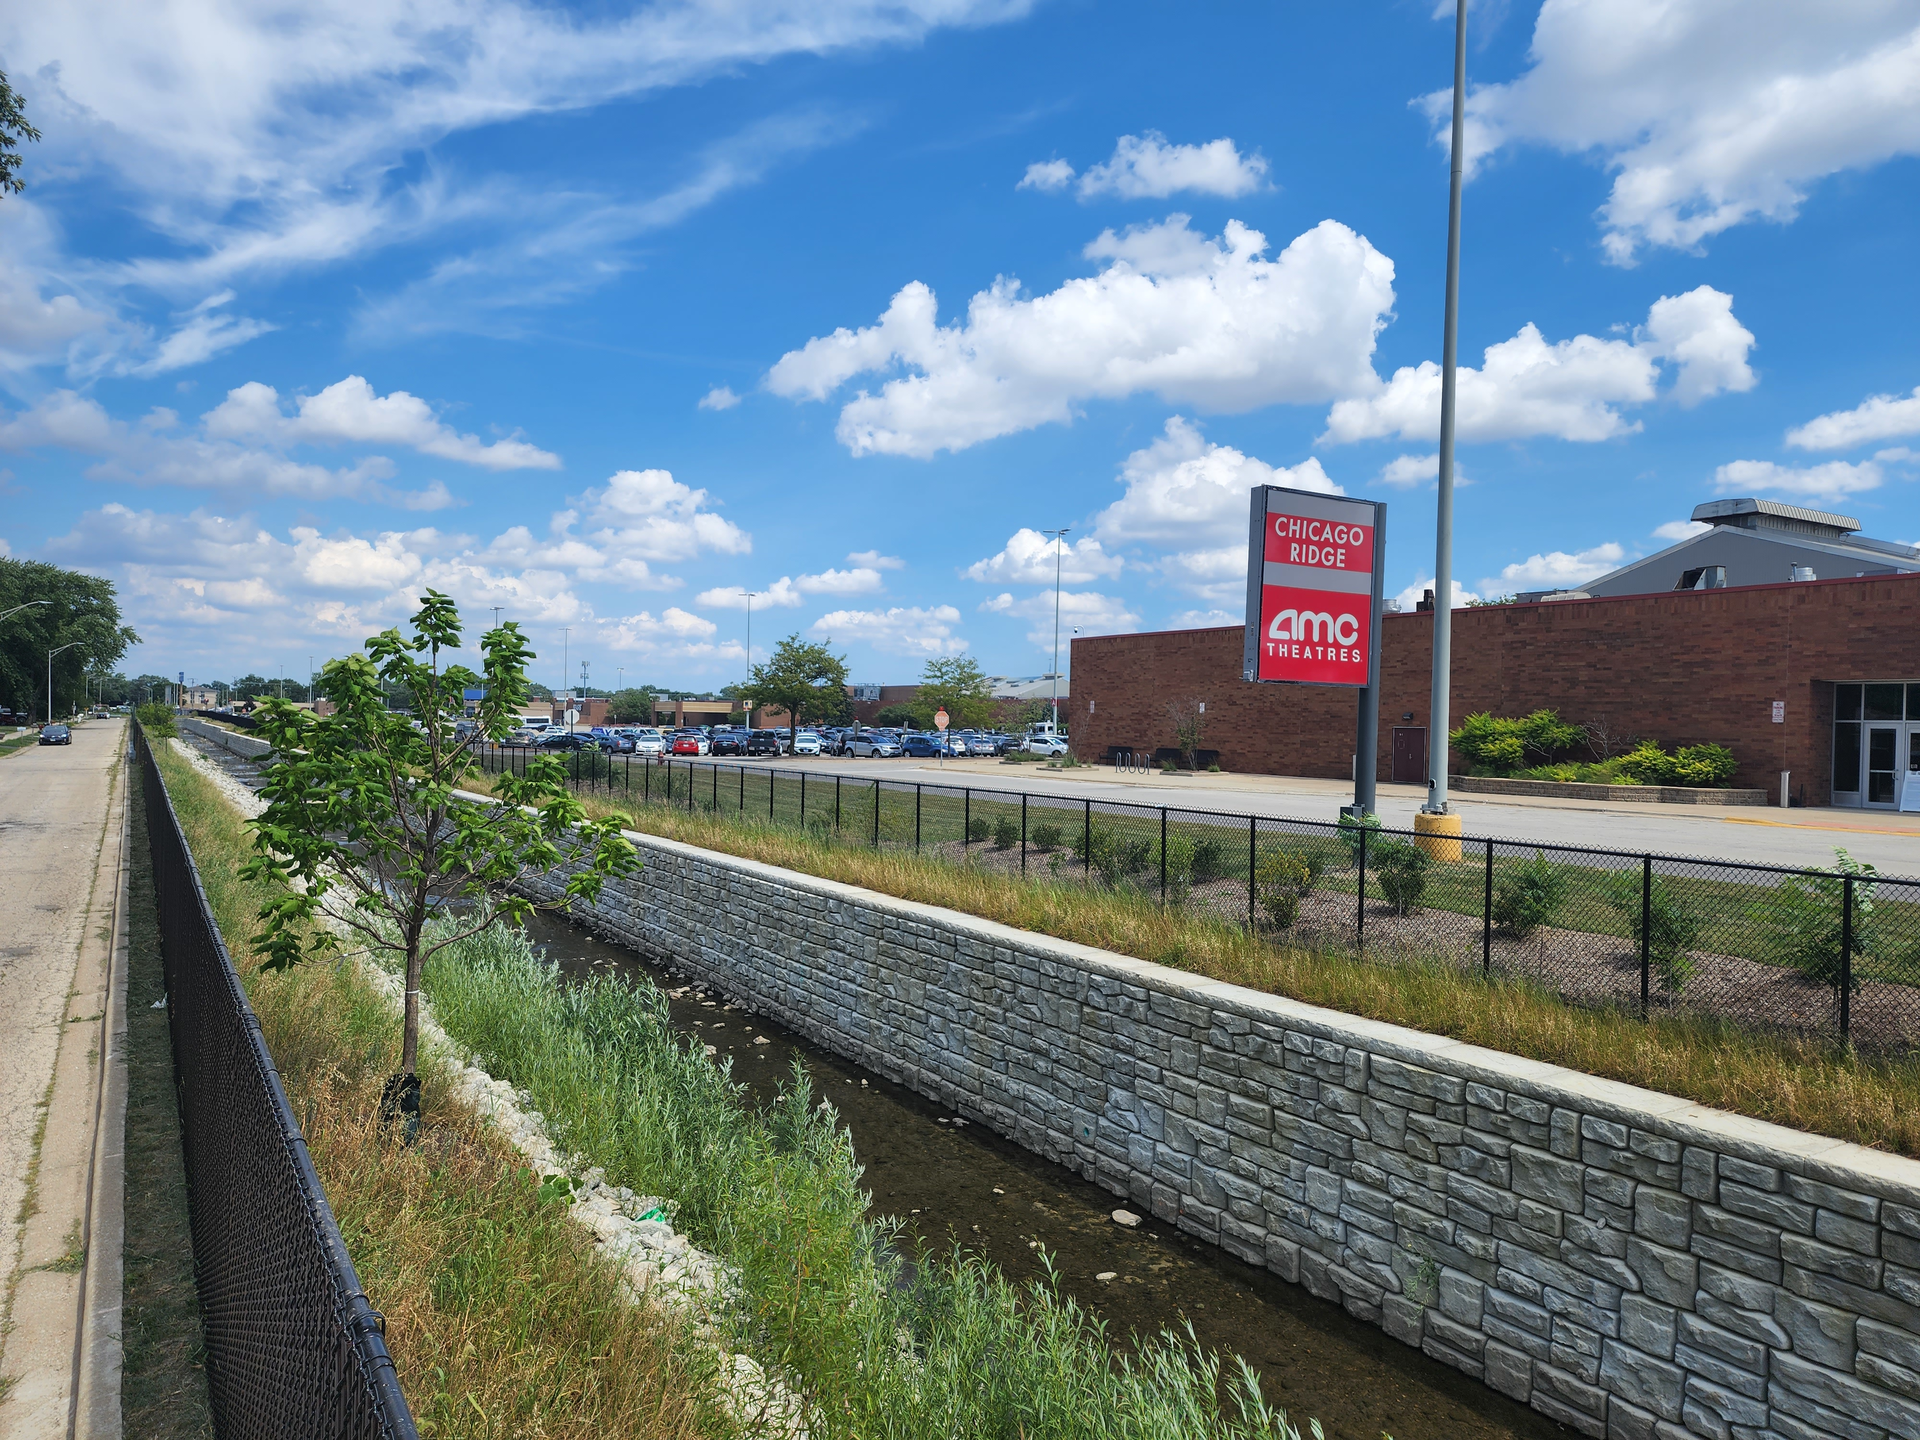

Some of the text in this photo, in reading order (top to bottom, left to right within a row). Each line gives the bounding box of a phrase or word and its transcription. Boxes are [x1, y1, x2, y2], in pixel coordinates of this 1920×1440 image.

[1275, 517, 1364, 546] CHICAGO
[1290, 542, 1346, 567] RIDGE
[1267, 642, 1361, 663] THEATRES
